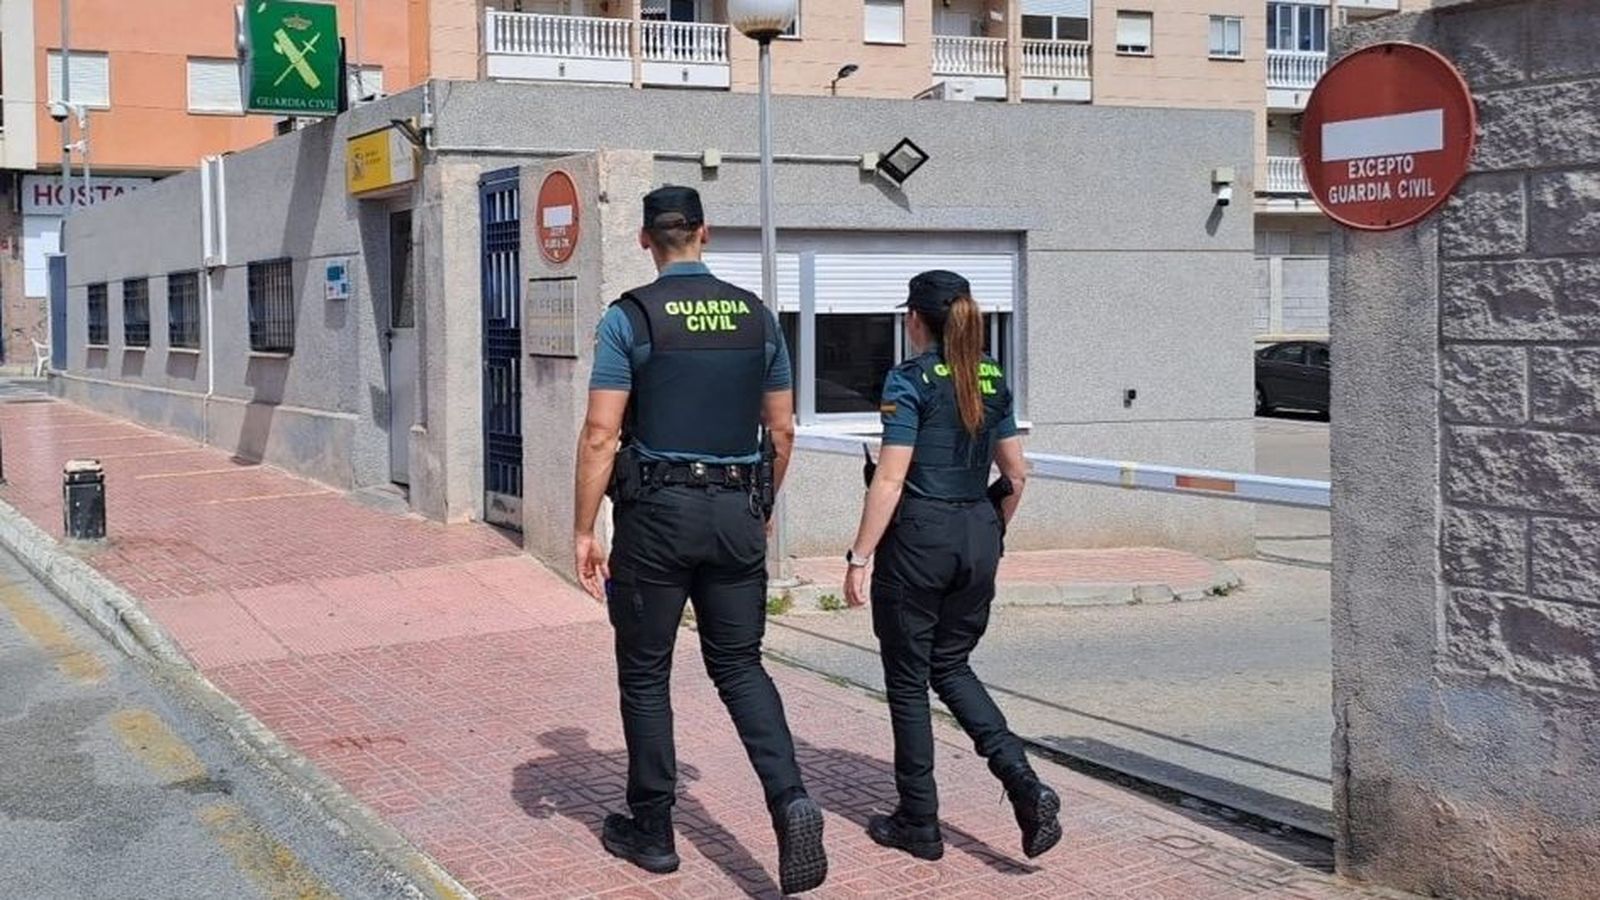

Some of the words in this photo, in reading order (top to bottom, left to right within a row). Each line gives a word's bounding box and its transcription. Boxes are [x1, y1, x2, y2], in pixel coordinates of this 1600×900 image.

[257, 96, 306, 107] GUARDIA
[308, 98, 336, 109] CIVIL
[1348, 155, 1414, 179] EXCEPTO
[34, 184, 137, 206] HOSTA
[1328, 183, 1392, 204] GUARDIA
[1397, 177, 1436, 198] CIVIL
[665, 300, 750, 315] GUARDIA
[686, 316, 737, 331] CIVIL
[934, 363, 1002, 377] GDIA
